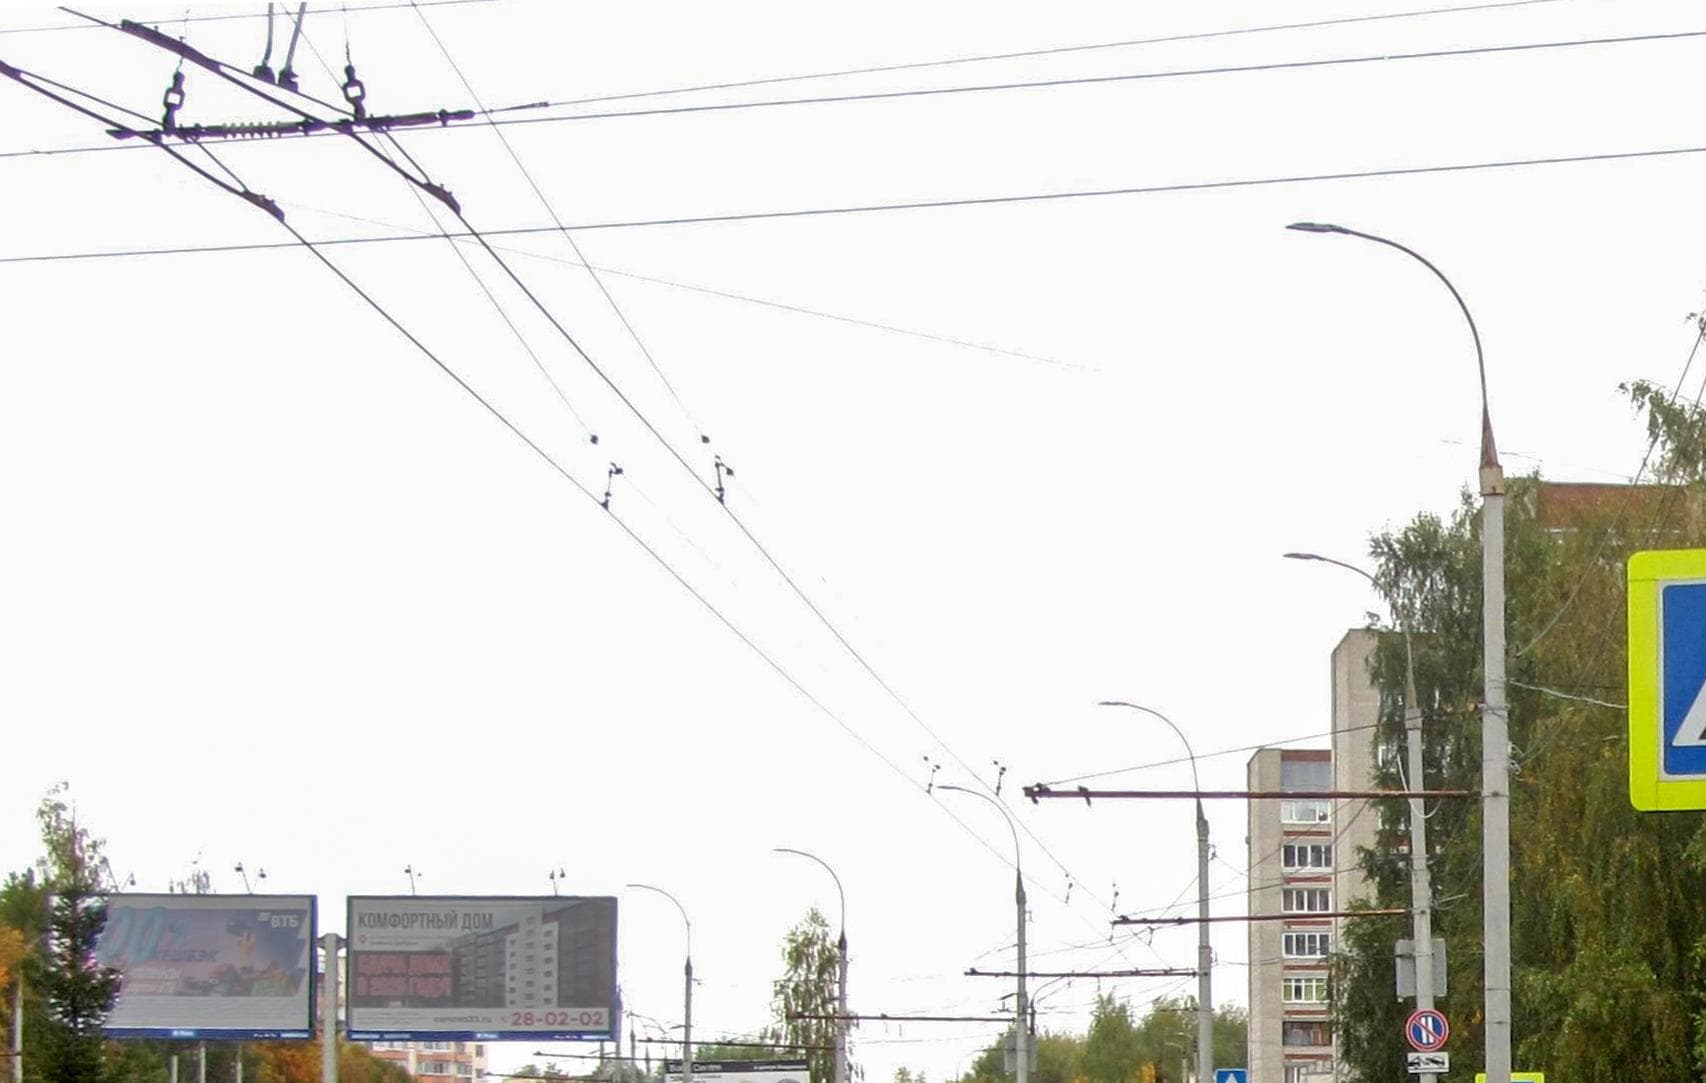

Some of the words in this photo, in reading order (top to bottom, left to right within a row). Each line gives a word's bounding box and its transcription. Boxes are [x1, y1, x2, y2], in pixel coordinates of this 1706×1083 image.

[271, 914, 299, 928] ВТБ
[358, 909, 459, 929] КОМФОРТНЫЙ
[462, 912, 494, 930] ДОМ
[511, 1011, 604, 1027] 28-02-02
